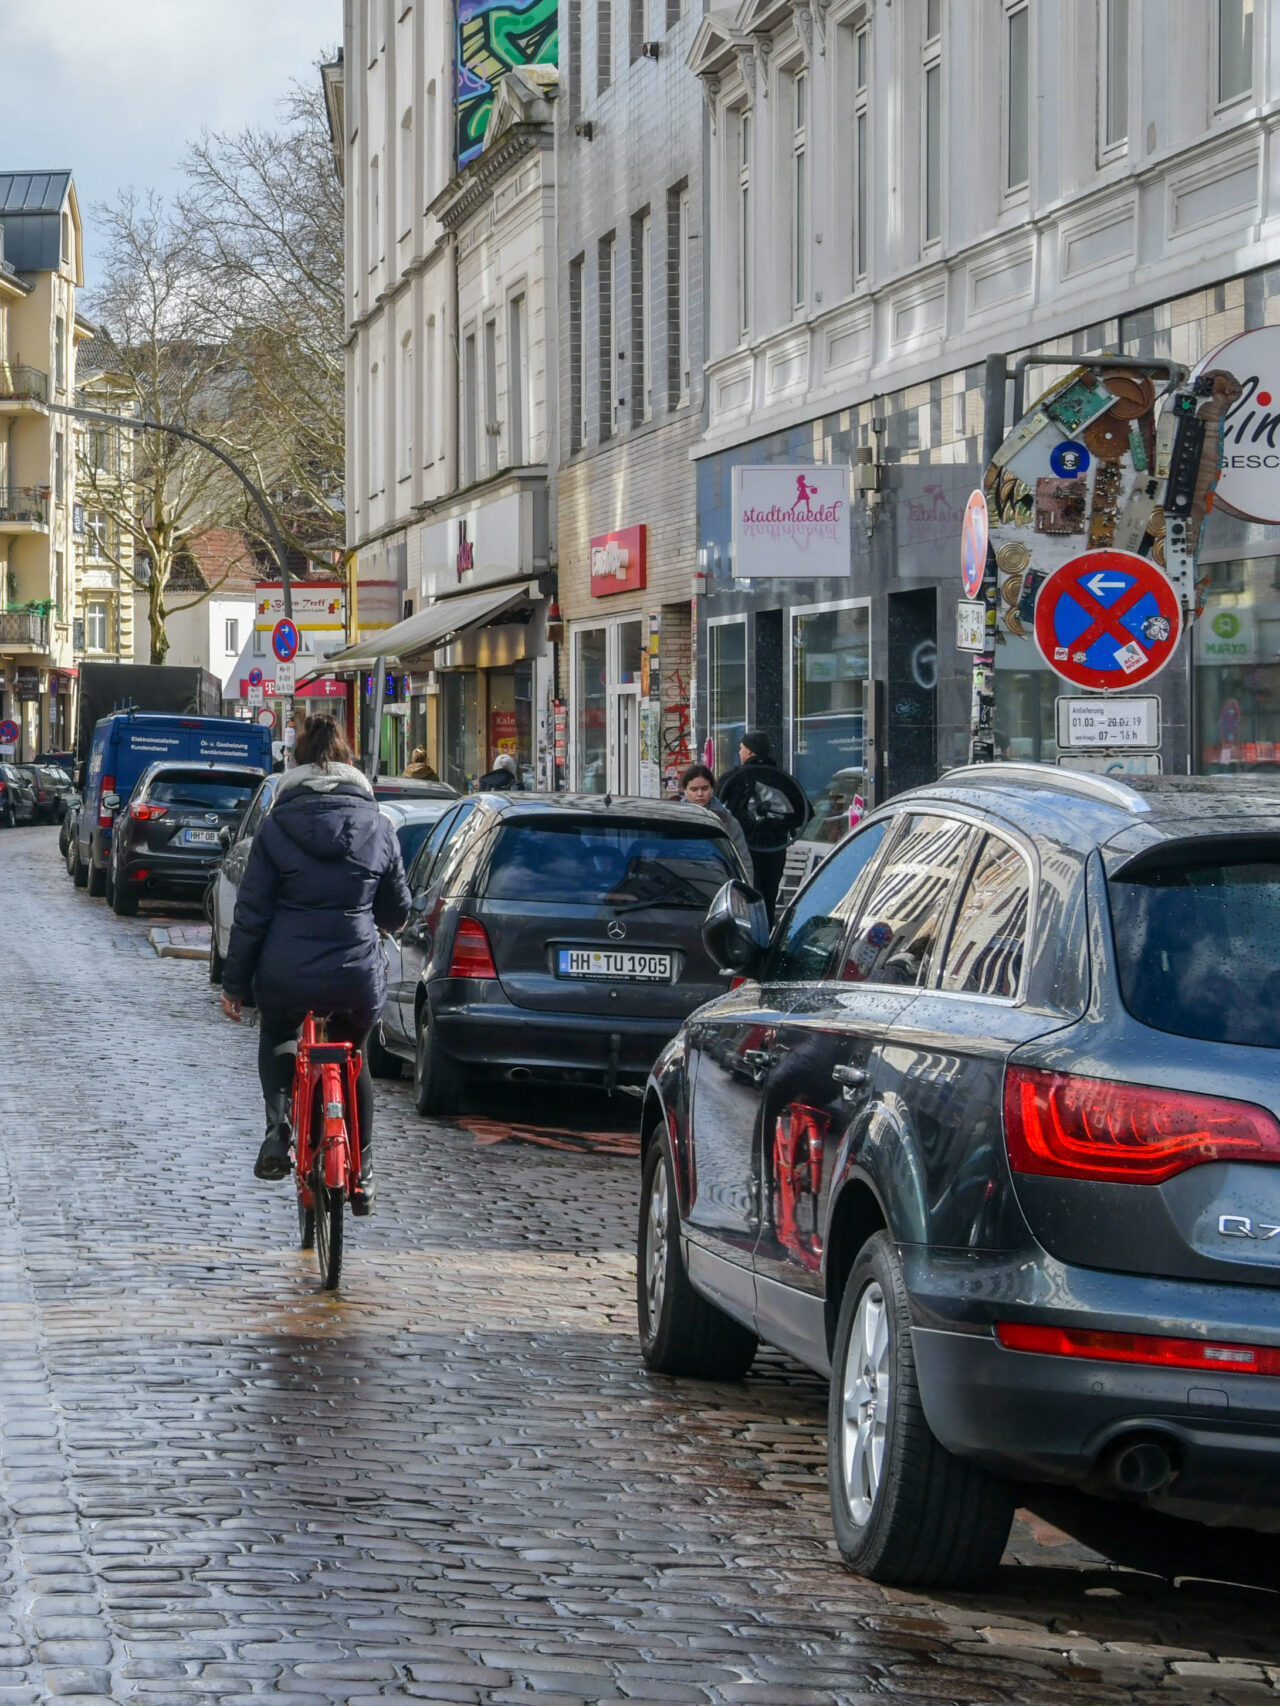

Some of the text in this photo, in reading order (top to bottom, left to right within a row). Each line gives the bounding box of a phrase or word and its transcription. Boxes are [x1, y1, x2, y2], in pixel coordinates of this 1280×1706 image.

[743, 500, 844, 523] stadtmaedel
[1072, 707, 1104, 715] Anlieferung
[131, 736, 179, 744] Elektroinstallation
[1098, 731, 1108, 740] 07
[131, 744, 168, 752] Kundendienst
[216, 741, 248, 750] Gasheizung
[200, 748, 248, 757] Sanitärinstallation
[570, 953, 667, 974] HH TU 1905
